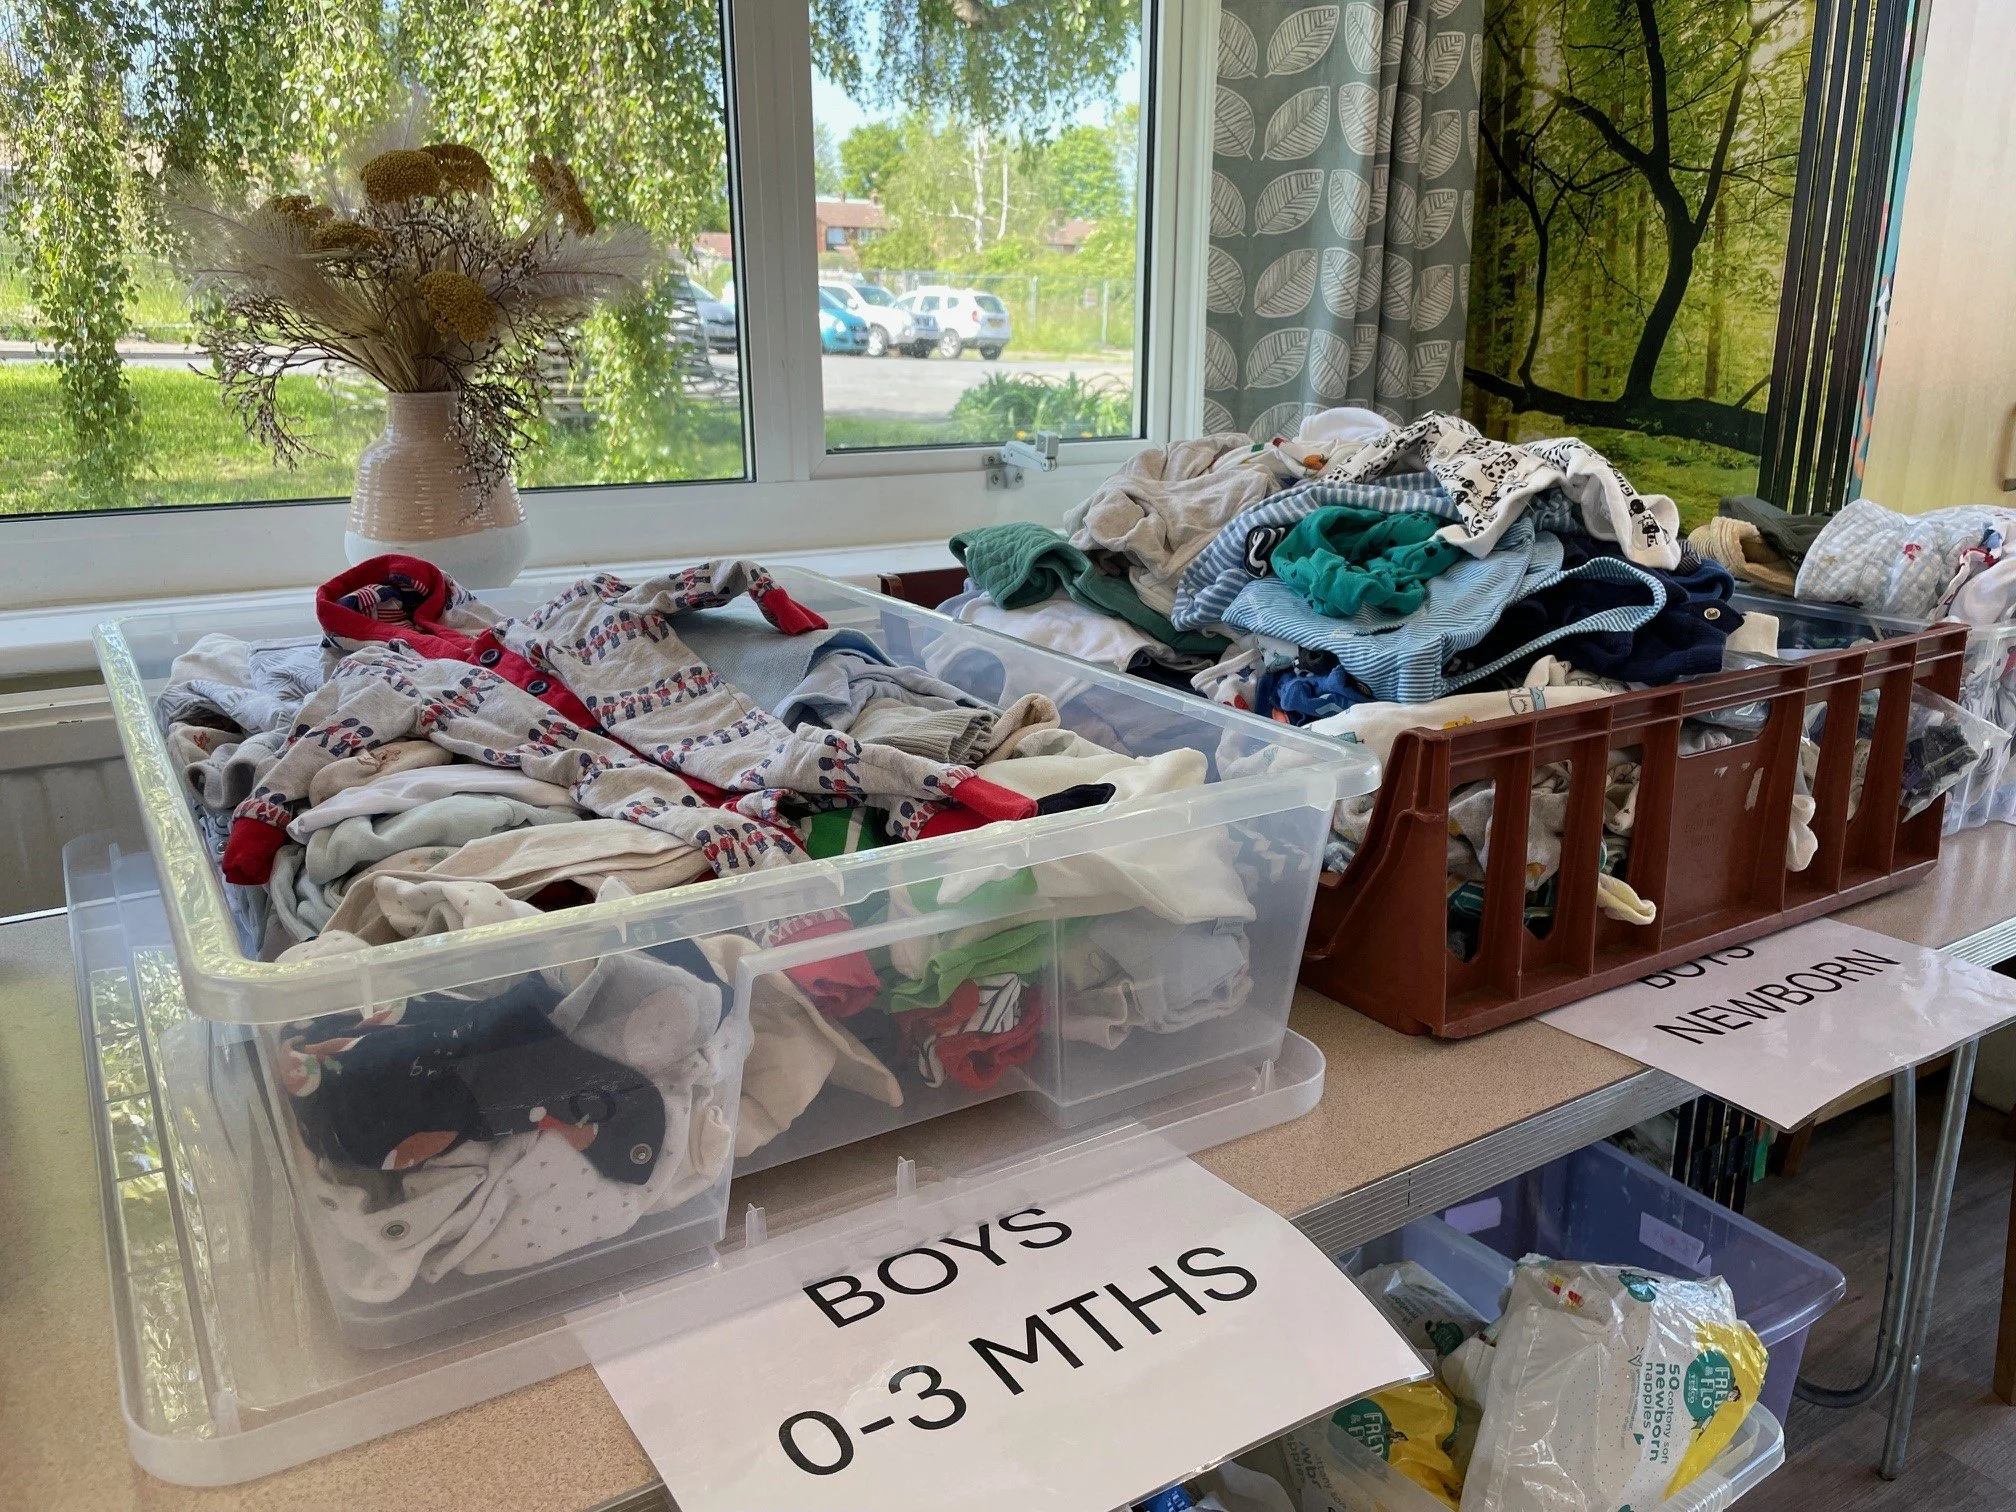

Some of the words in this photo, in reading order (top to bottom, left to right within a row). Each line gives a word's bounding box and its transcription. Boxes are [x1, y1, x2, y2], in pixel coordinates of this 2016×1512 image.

[1653, 949, 1901, 1045] NEWBORN
[802, 1208, 1072, 1328] BOYS
[778, 1364, 967, 1476] 0-3
[968, 1246, 1258, 1396] MTHS
[1643, 1362, 1654, 1429] nappies
[1700, 1378, 1714, 1409] FLO
[1649, 1362, 1667, 1462] newborn
[1663, 1391, 1675, 1439] cottony
[1660, 1441, 1671, 1465] soft
